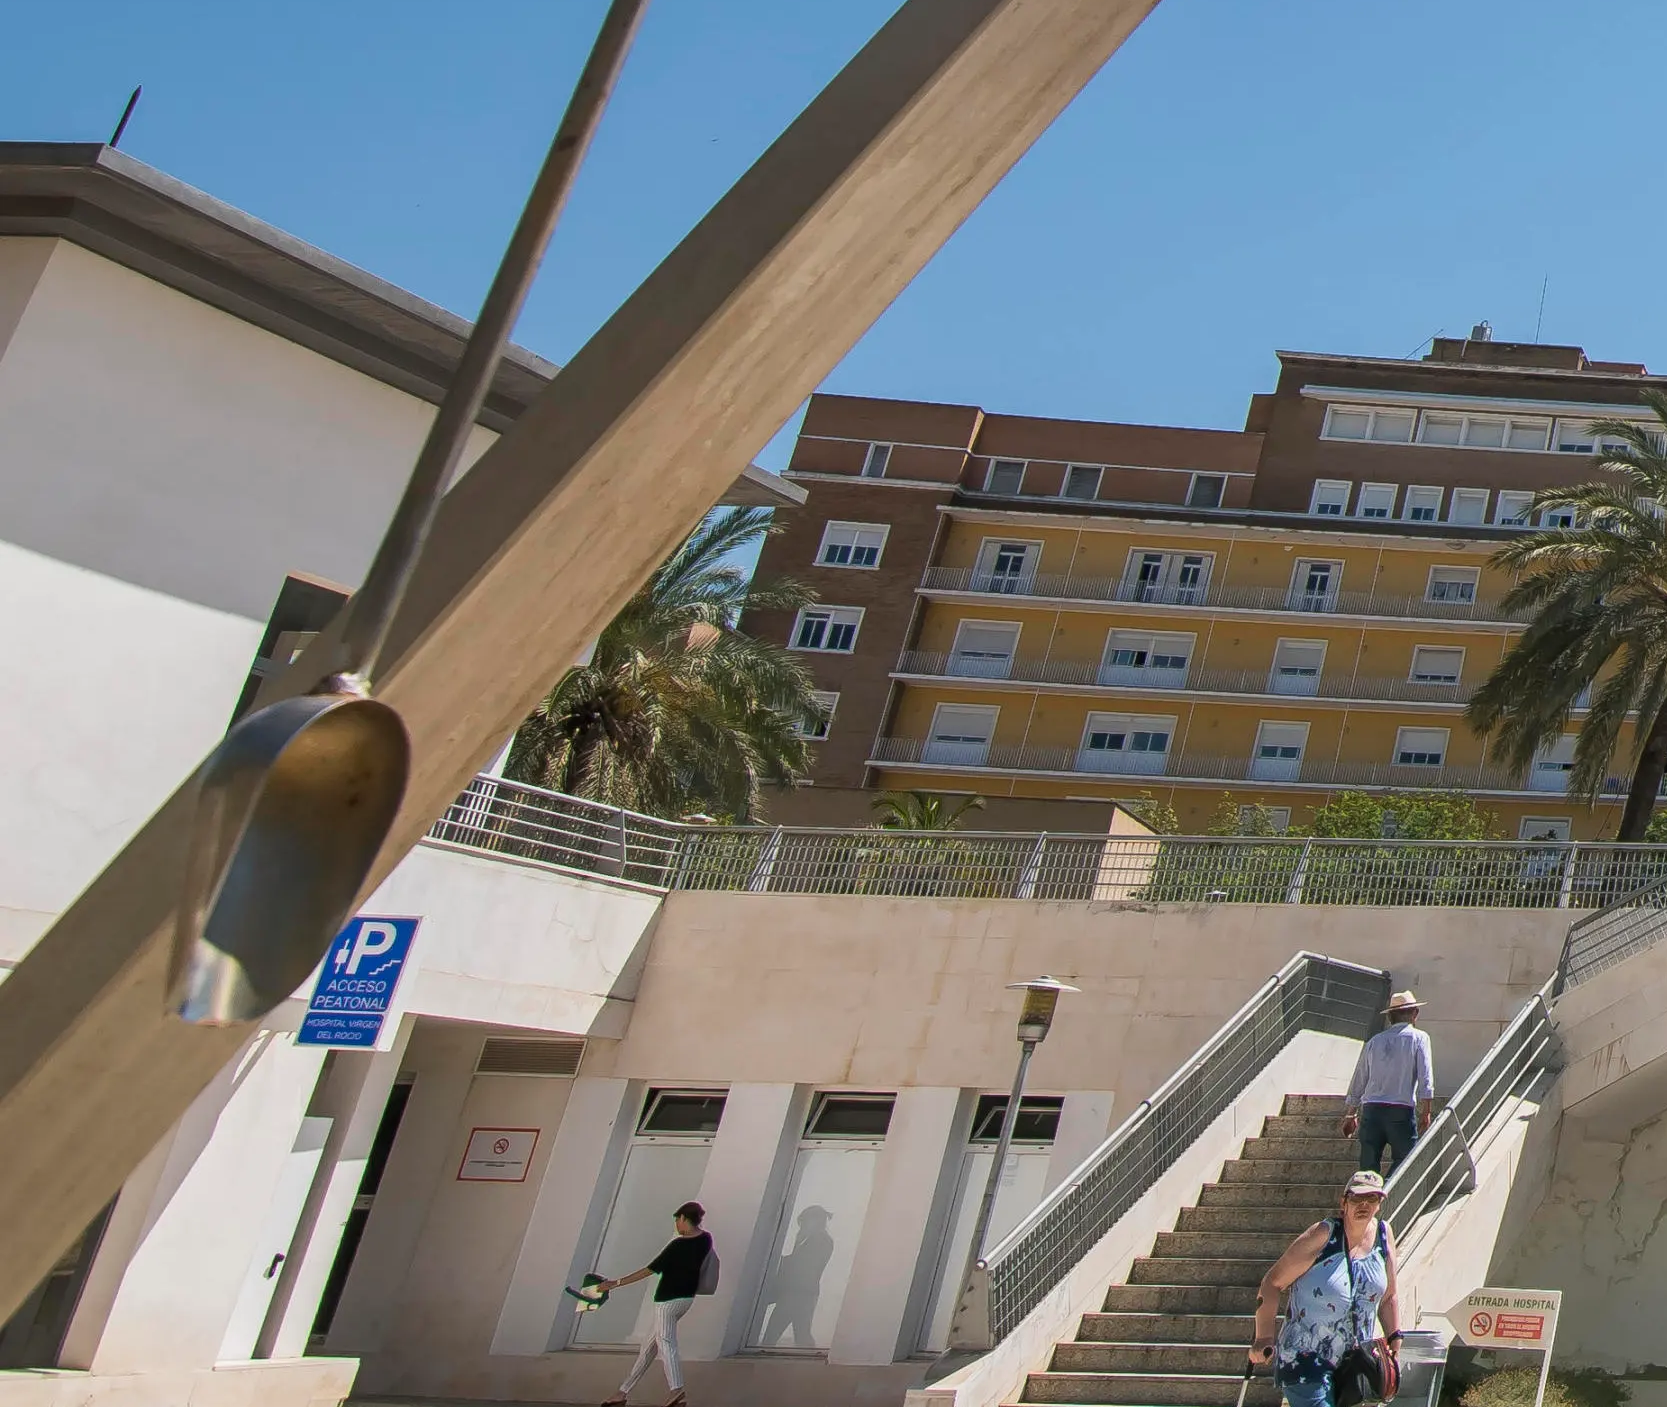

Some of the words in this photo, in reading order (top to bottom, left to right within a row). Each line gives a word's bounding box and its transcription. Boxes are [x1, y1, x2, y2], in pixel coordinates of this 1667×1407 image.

[345, 921, 397, 975] P
[326, 978, 387, 993] ACCESO
[314, 995, 386, 1010] PEATONAL
[1467, 1296, 1510, 1307] ENTRADA
[1513, 1298, 1556, 1310] HOSPITAL
